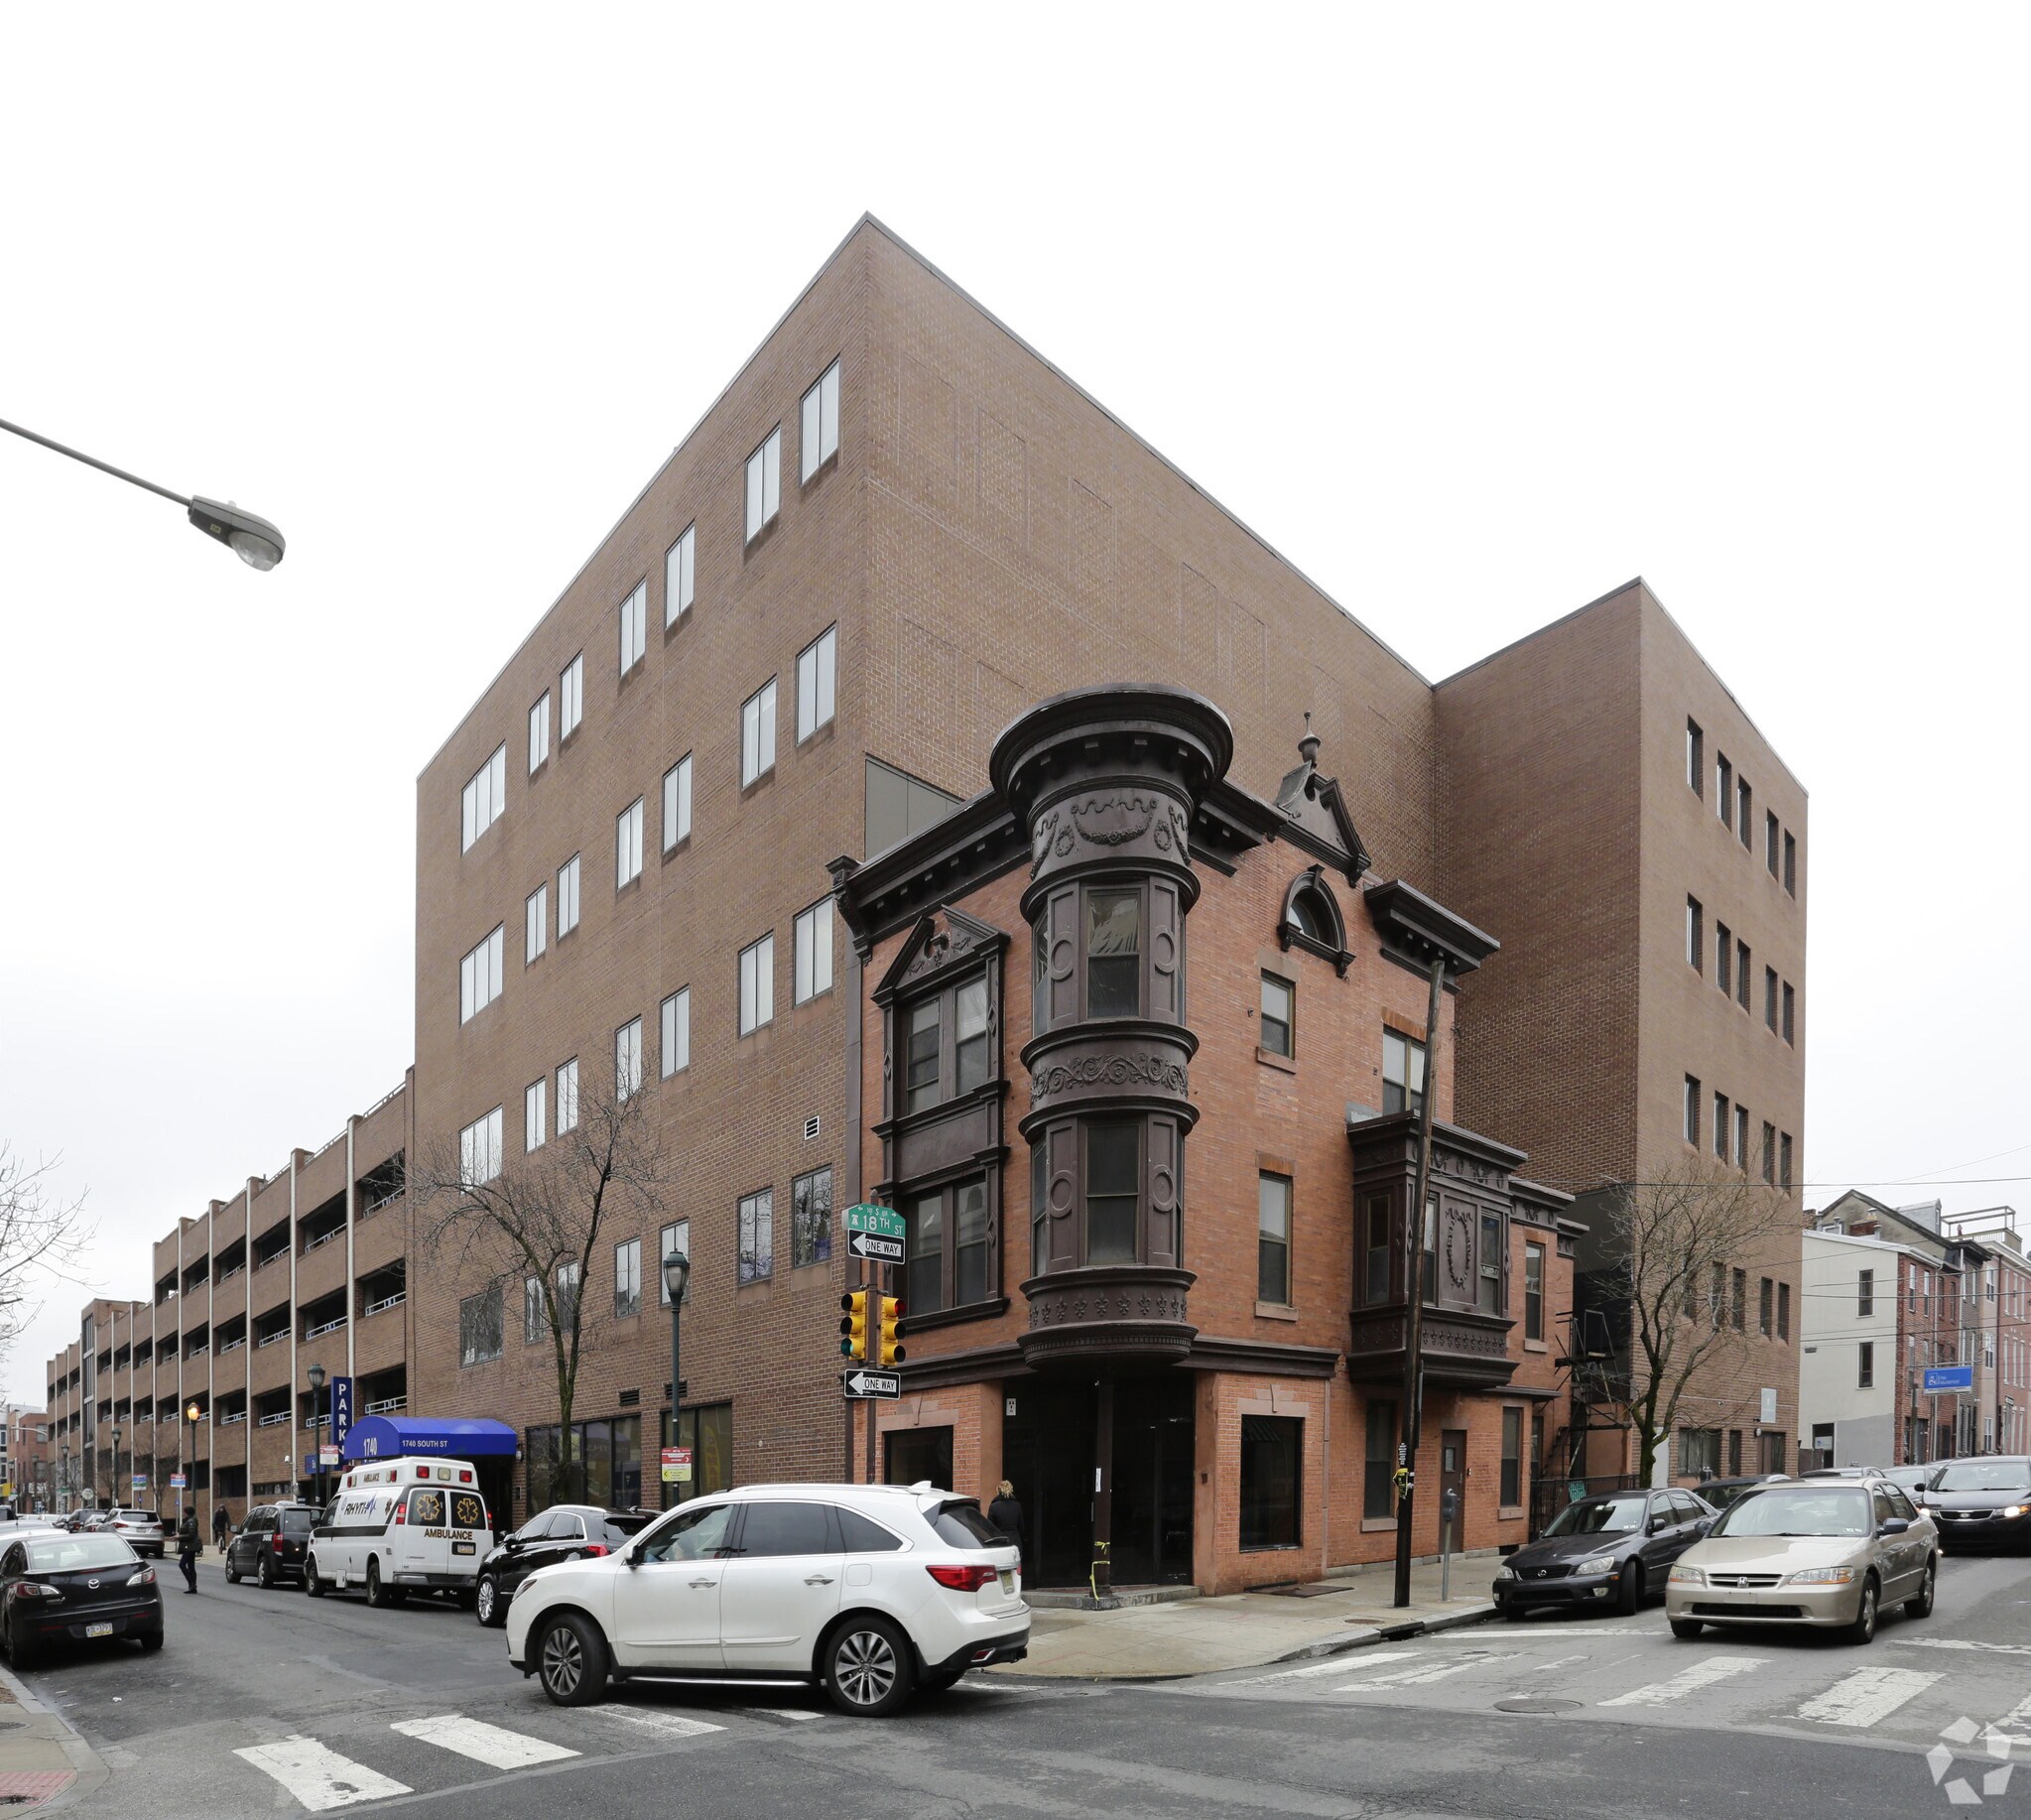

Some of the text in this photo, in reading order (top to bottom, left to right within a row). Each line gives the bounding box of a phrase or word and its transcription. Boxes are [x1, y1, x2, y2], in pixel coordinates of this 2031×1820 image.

[894, 1225, 903, 1235] ST
[865, 1240, 899, 1254] ONE WAY
[864, 1378, 895, 1390] ONE WAY
[338, 1383, 347, 1442] PARK
[363, 1437, 377, 1457] 1740
[424, 1528, 473, 1540] AMBULANCE
